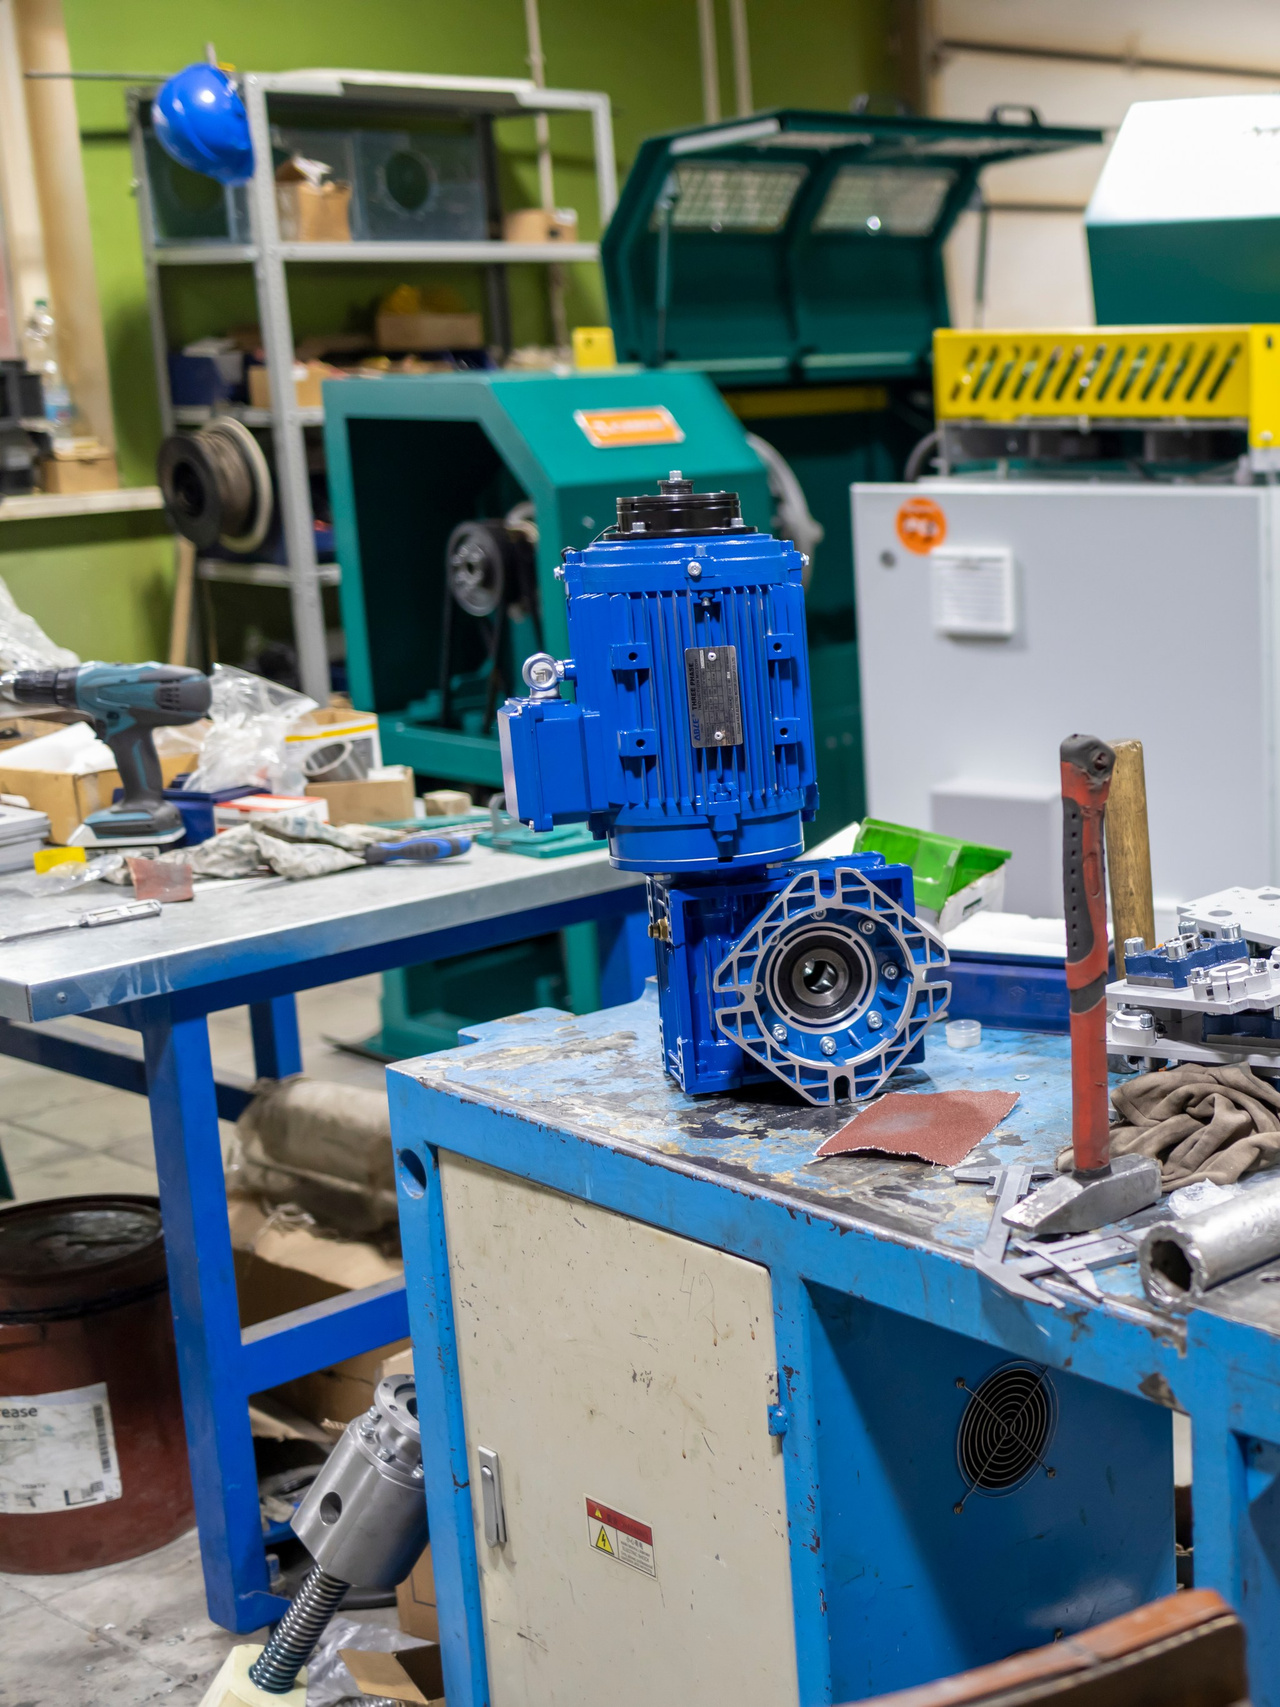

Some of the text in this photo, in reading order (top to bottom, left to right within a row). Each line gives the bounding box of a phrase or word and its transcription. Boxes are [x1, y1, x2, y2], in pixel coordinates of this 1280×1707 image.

[688, 662, 698, 711] THREE PHASE
[692, 717, 701, 741] ABLE
[0, 1407, 38, 1418] ease
